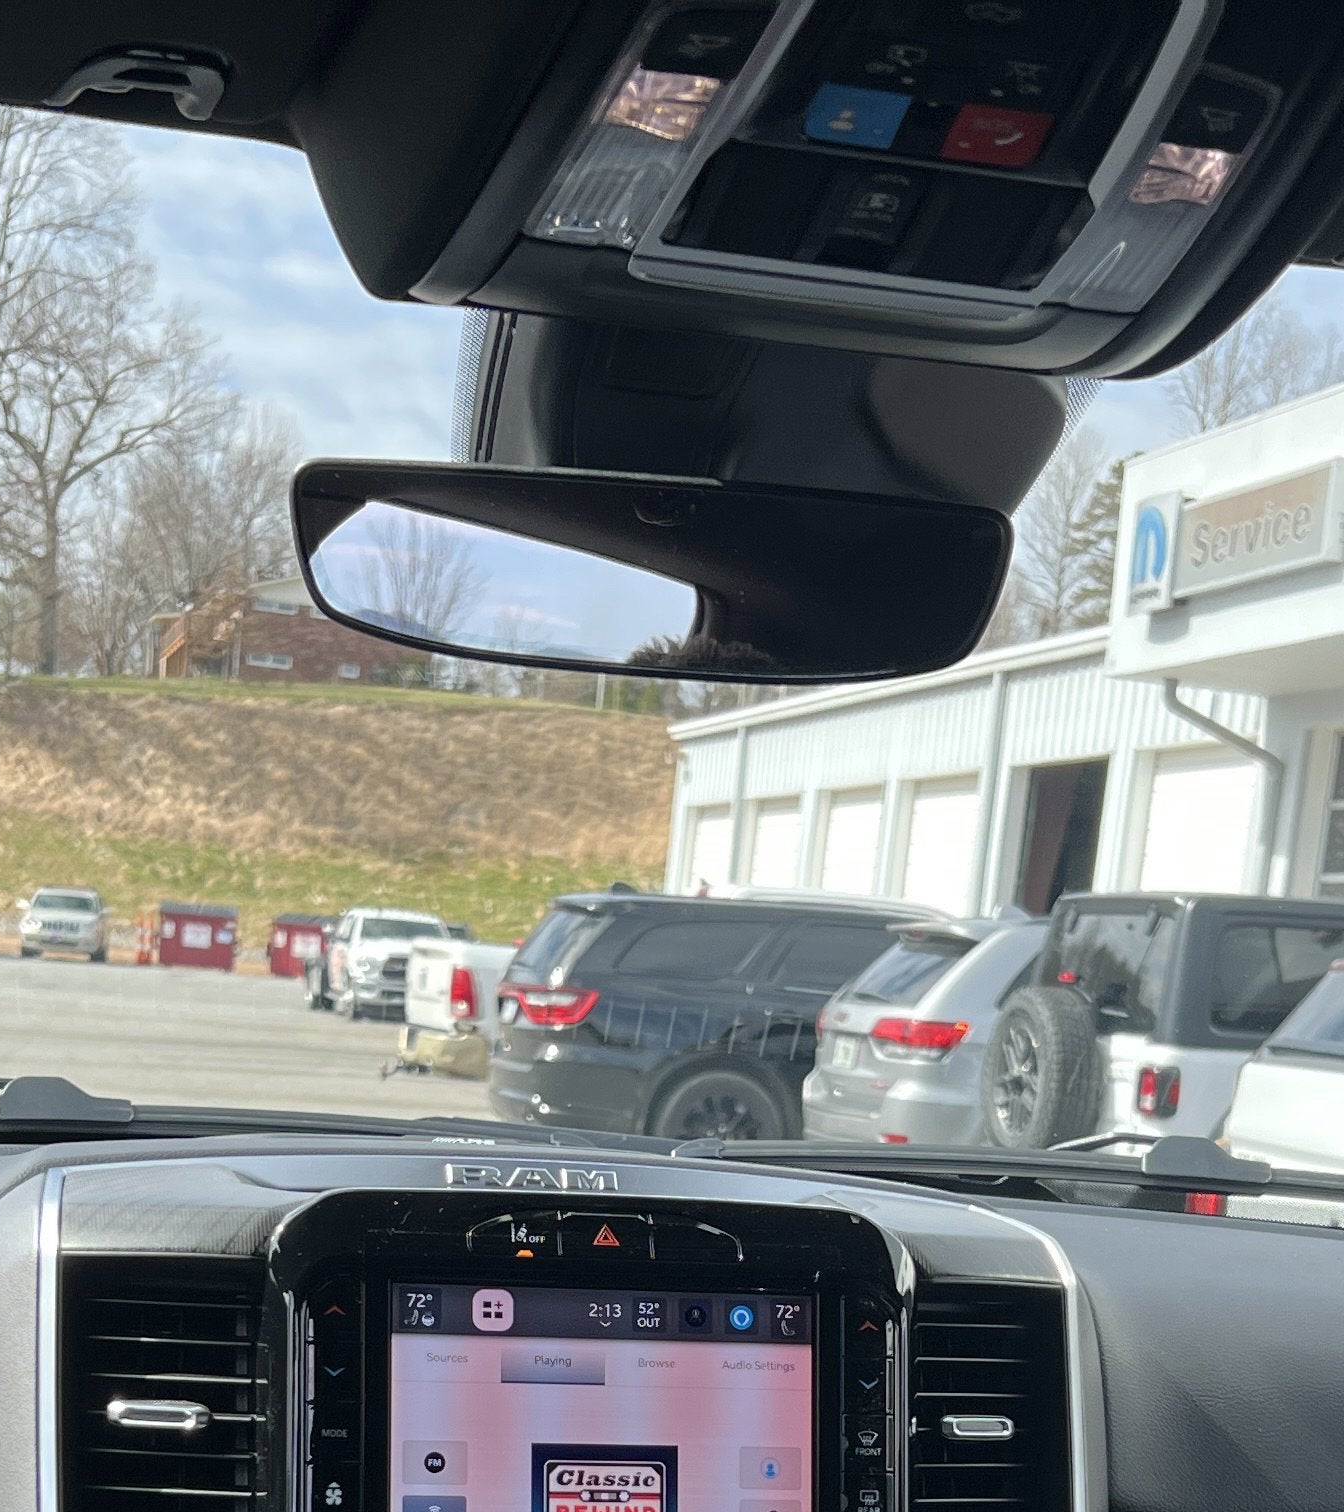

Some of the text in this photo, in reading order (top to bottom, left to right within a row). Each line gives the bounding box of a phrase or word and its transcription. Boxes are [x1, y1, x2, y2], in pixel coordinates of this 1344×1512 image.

[1191, 500, 1312, 568] Service
[443, 1163, 620, 1191] RAM
[529, 1235, 546, 1243] OFF
[407, 1293, 433, 1309] 72°
[589, 1303, 622, 1318] 2:13
[638, 1302, 660, 1316] 52°
[776, 1304, 800, 1319] 72°
[637, 1317, 660, 1329] OUT
[426, 1352, 469, 1364] Sources
[534, 1354, 572, 1368] Playing
[638, 1357, 675, 1369] Browse
[722, 1359, 796, 1374] Audio Settings
[322, 1429, 348, 1438] MODE
[856, 1447, 882, 1457] FRONT
[427, 1458, 443, 1468] FM
[556, 1469, 656, 1489] Classic
